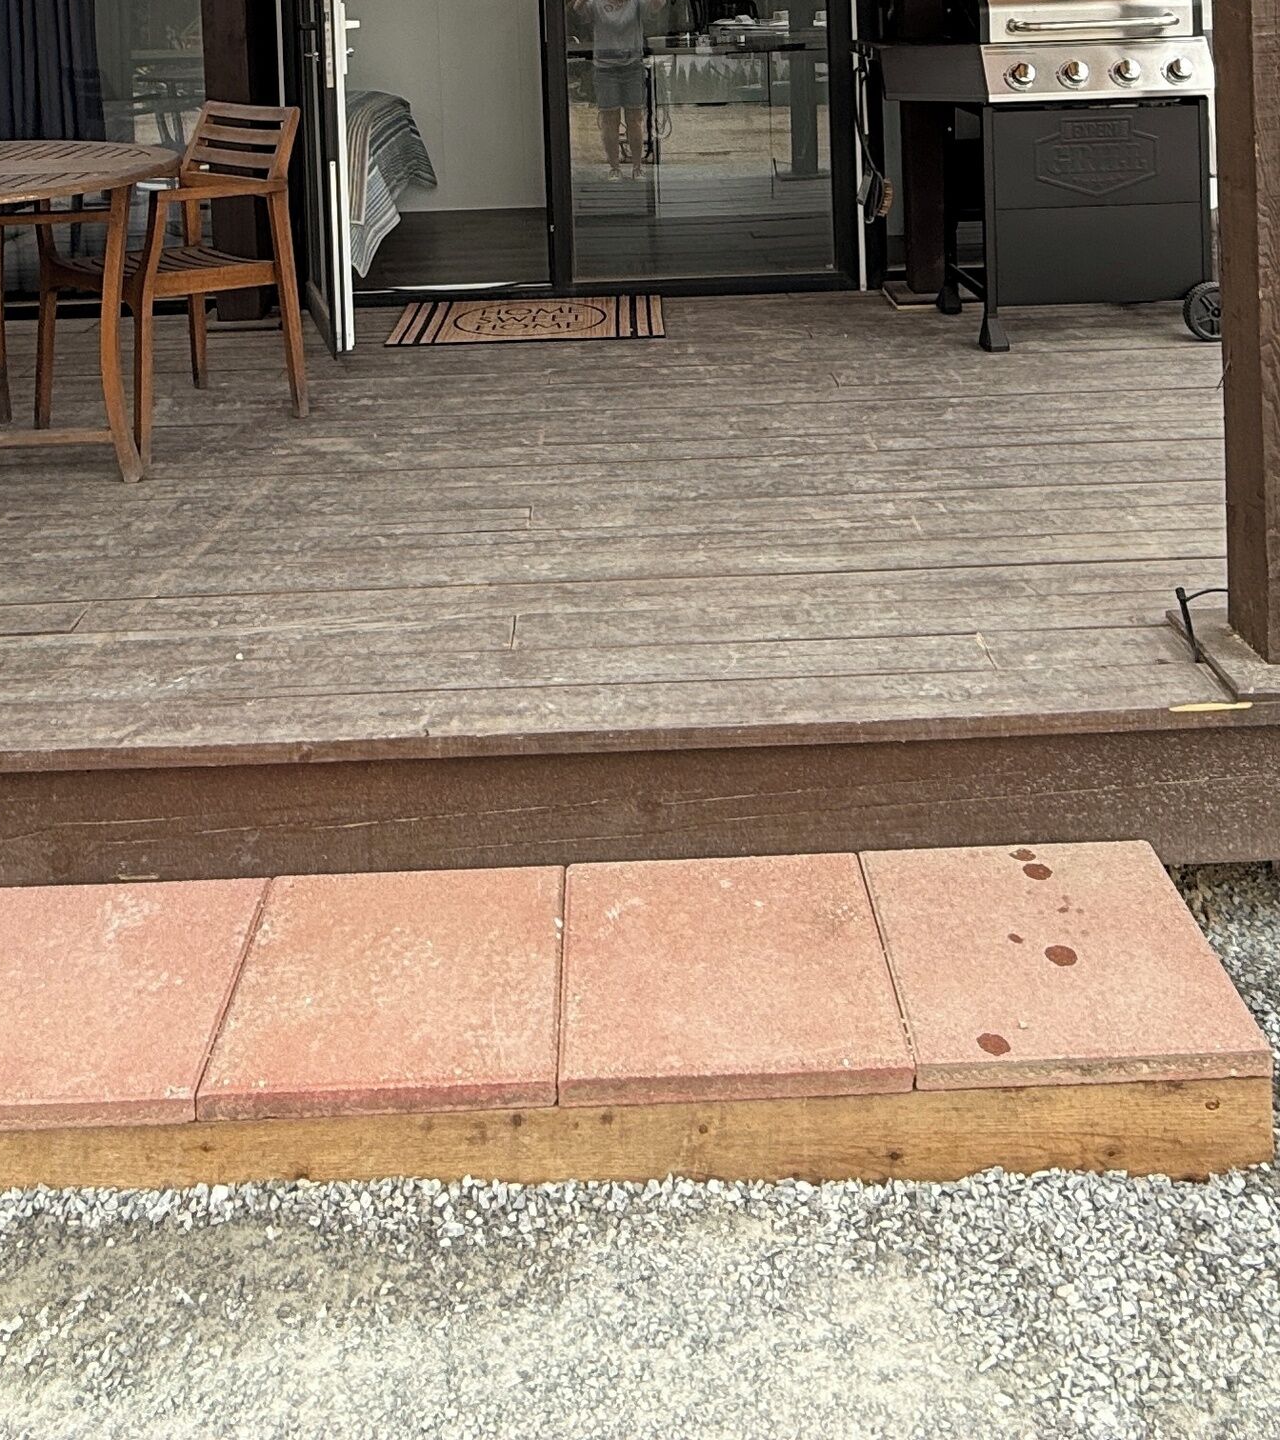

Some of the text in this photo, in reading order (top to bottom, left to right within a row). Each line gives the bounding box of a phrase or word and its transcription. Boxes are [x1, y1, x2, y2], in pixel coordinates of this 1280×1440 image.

[482, 307, 584, 316] HOME
[476, 314, 583, 324] SWEET
[476, 322, 582, 331] HOME
